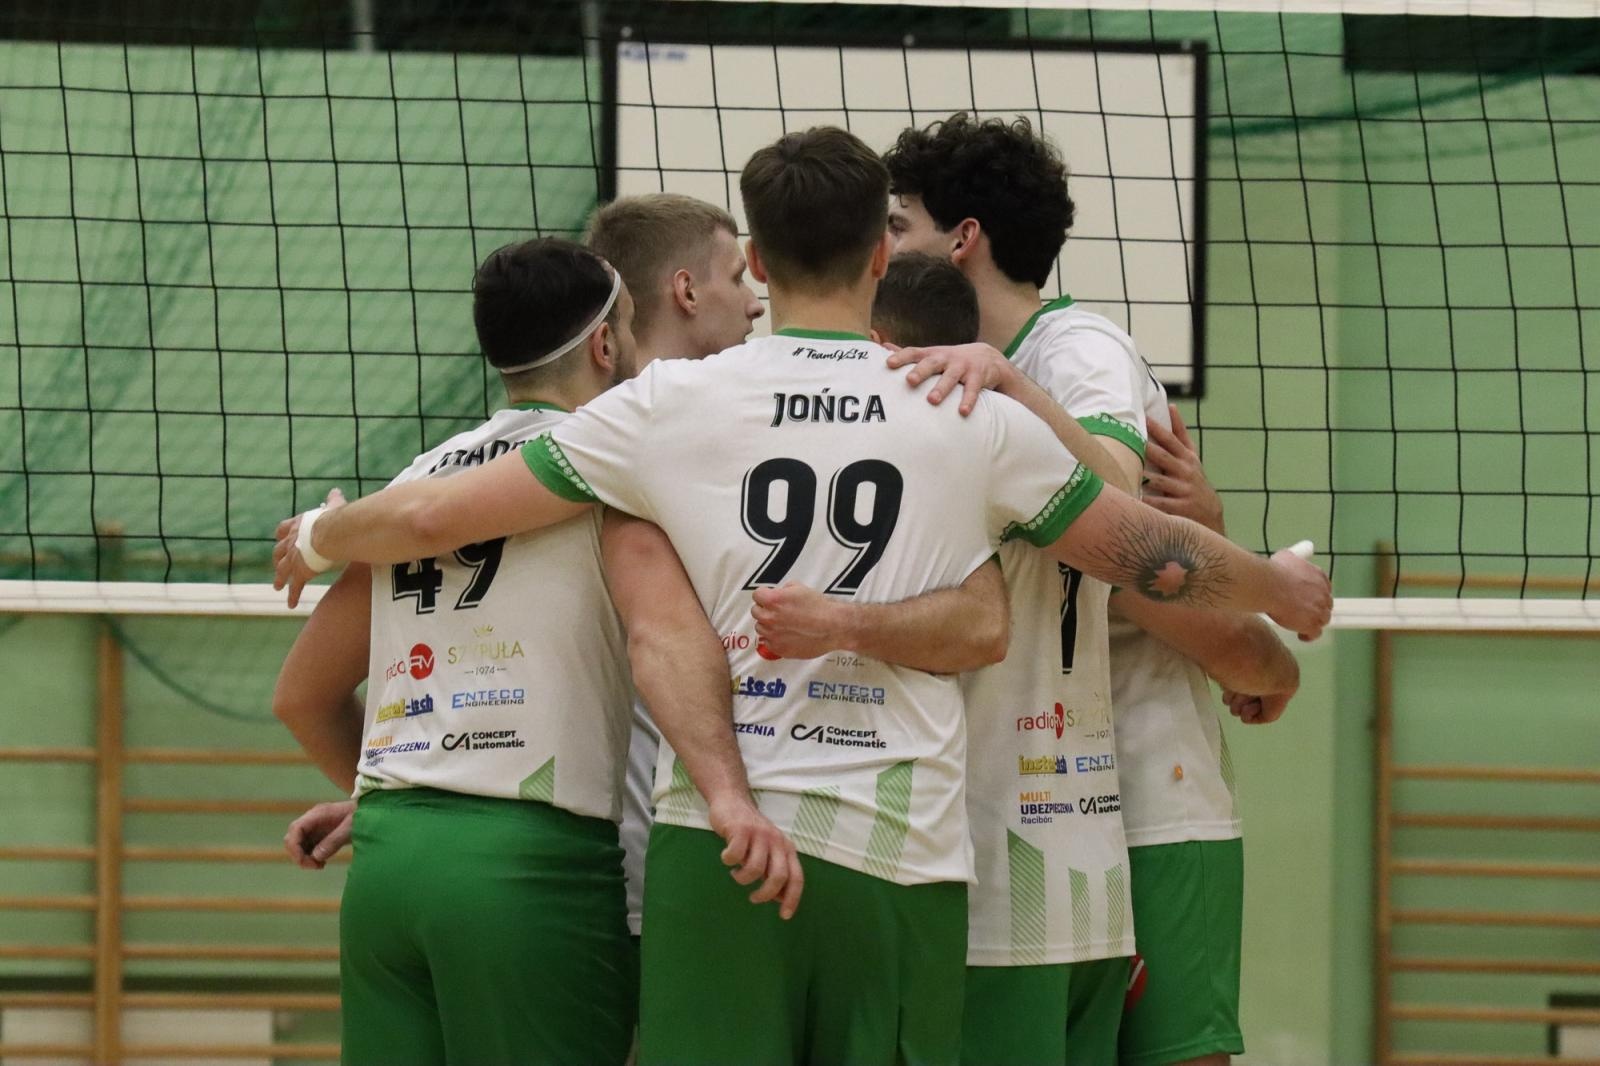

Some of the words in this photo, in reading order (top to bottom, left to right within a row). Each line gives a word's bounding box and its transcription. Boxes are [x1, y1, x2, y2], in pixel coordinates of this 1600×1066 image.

[771, 388, 886, 427] JOŃCA
[741, 458, 904, 595] 99
[452, 688, 525, 709] ENTECO
[808, 681, 885, 699] ENTECO
[1017, 711, 1055, 731] radio
[472, 731, 516, 740] CONCEPT
[827, 726, 877, 738] CONCEPT
[472, 738, 525, 749] automatic
[826, 738, 887, 749] automatic
